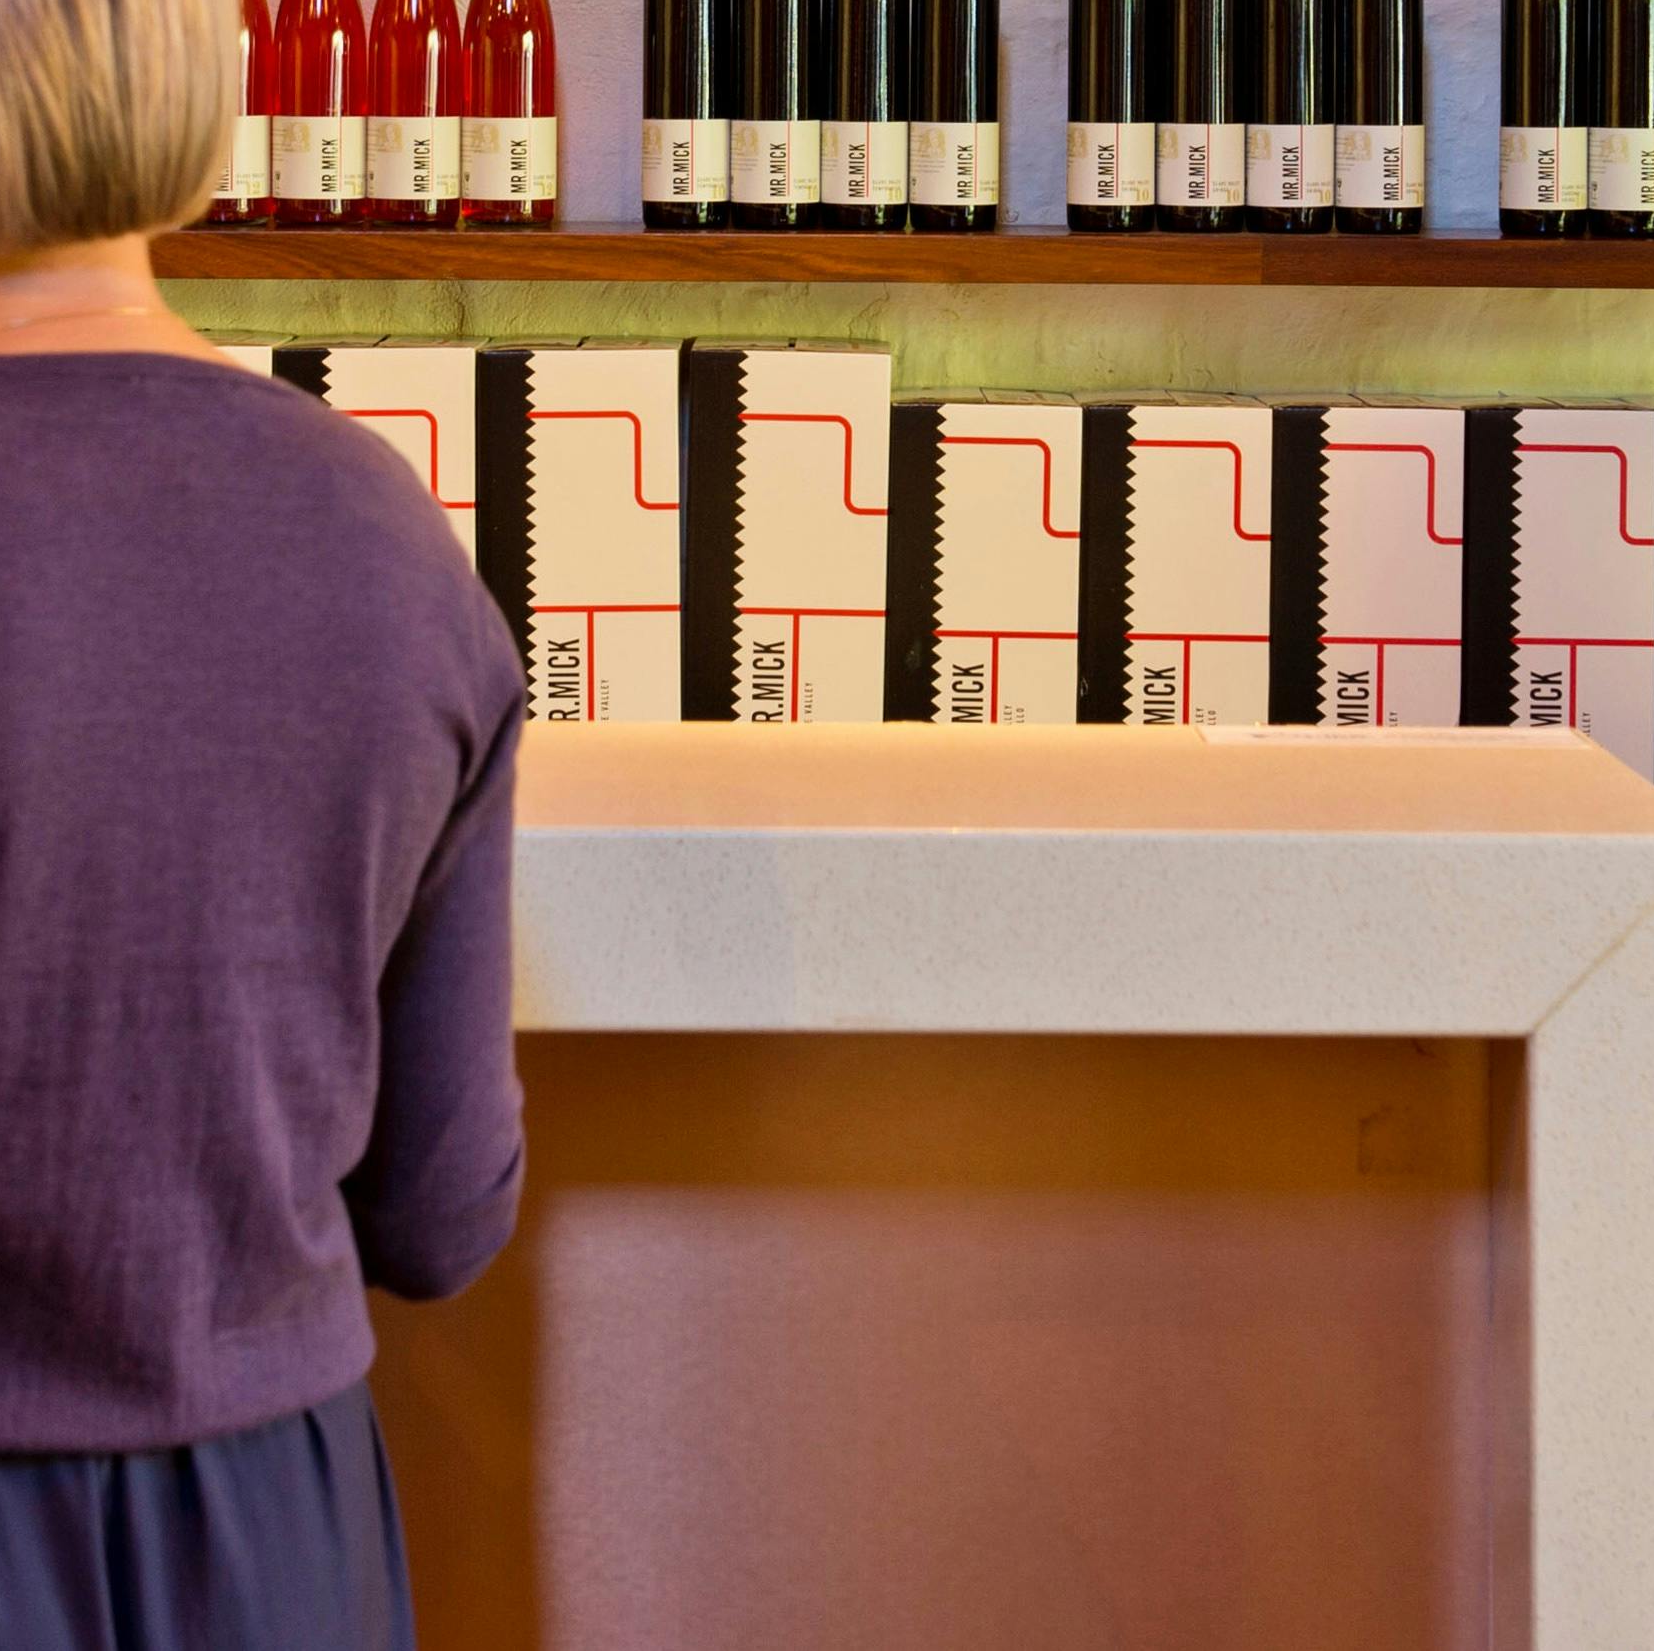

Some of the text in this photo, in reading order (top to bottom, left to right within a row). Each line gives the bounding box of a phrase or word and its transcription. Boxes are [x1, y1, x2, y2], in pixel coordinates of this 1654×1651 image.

[547, 638, 580, 721] R.MICK
[751, 641, 785, 723] R.MICK
[951, 663, 984, 723] MICK
[1143, 666, 1176, 724] MICK
[1337, 670, 1370, 727] MICK
[1530, 671, 1563, 727] MICK
